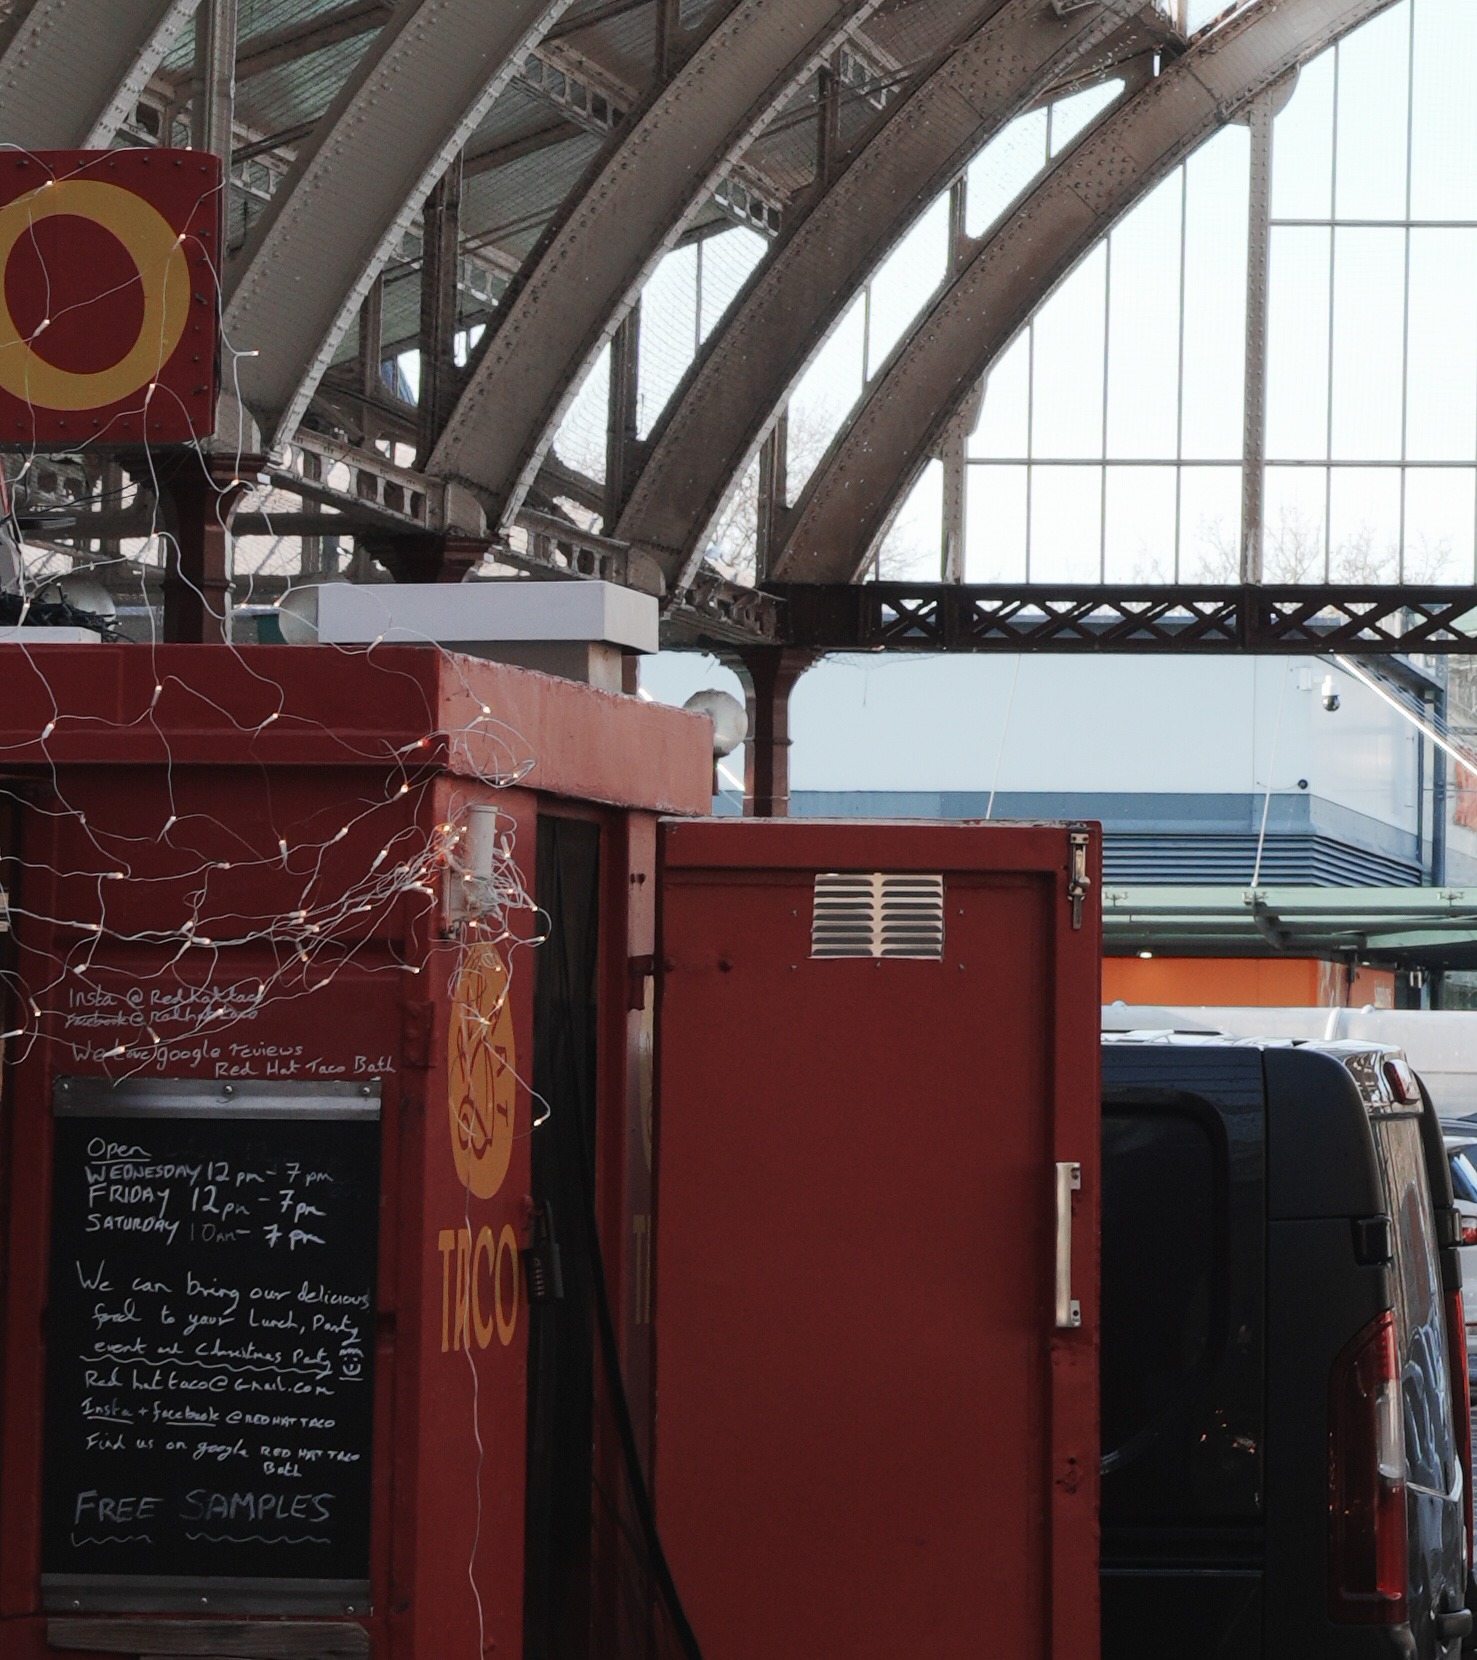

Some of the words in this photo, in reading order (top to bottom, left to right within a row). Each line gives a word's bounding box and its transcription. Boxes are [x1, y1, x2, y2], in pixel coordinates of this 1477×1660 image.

[69, 986, 116, 1007] Insta
[72, 1042, 105, 1063] We
[156, 1039, 220, 1070] google
[215, 1061, 259, 1077] Red
[266, 1062, 302, 1075] Hat
[305, 1058, 346, 1074] Taco
[353, 1055, 397, 1074] Bath
[87, 1137, 152, 1158] Open
[85, 1162, 203, 1187] WEDNESDAY
[88, 1182, 170, 1218] FRIDAY
[85, 1213, 181, 1246] SATURDAY
[76, 1258, 114, 1292] We
[131, 1278, 172, 1294] can
[187, 1271, 240, 1315] bring
[249, 1286, 291, 1301] our
[297, 1281, 370, 1309] delicious
[438, 1223, 520, 1354] TACO
[91, 1298, 142, 1330] food
[160, 1306, 176, 1325] to
[184, 1314, 236, 1337] your
[94, 1337, 147, 1354] event
[195, 1339, 282, 1363] Christmas
[81, 1396, 133, 1418] Insta
[86, 1431, 126, 1451] Find
[136, 1438, 154, 1449] us
[166, 1439, 188, 1450] on
[192, 1438, 249, 1462] google
[260, 1445, 292, 1459] RED
[263, 1461, 302, 1477] Bath
[74, 1489, 165, 1525] FREE
[178, 1488, 337, 1524] SAMPLES
